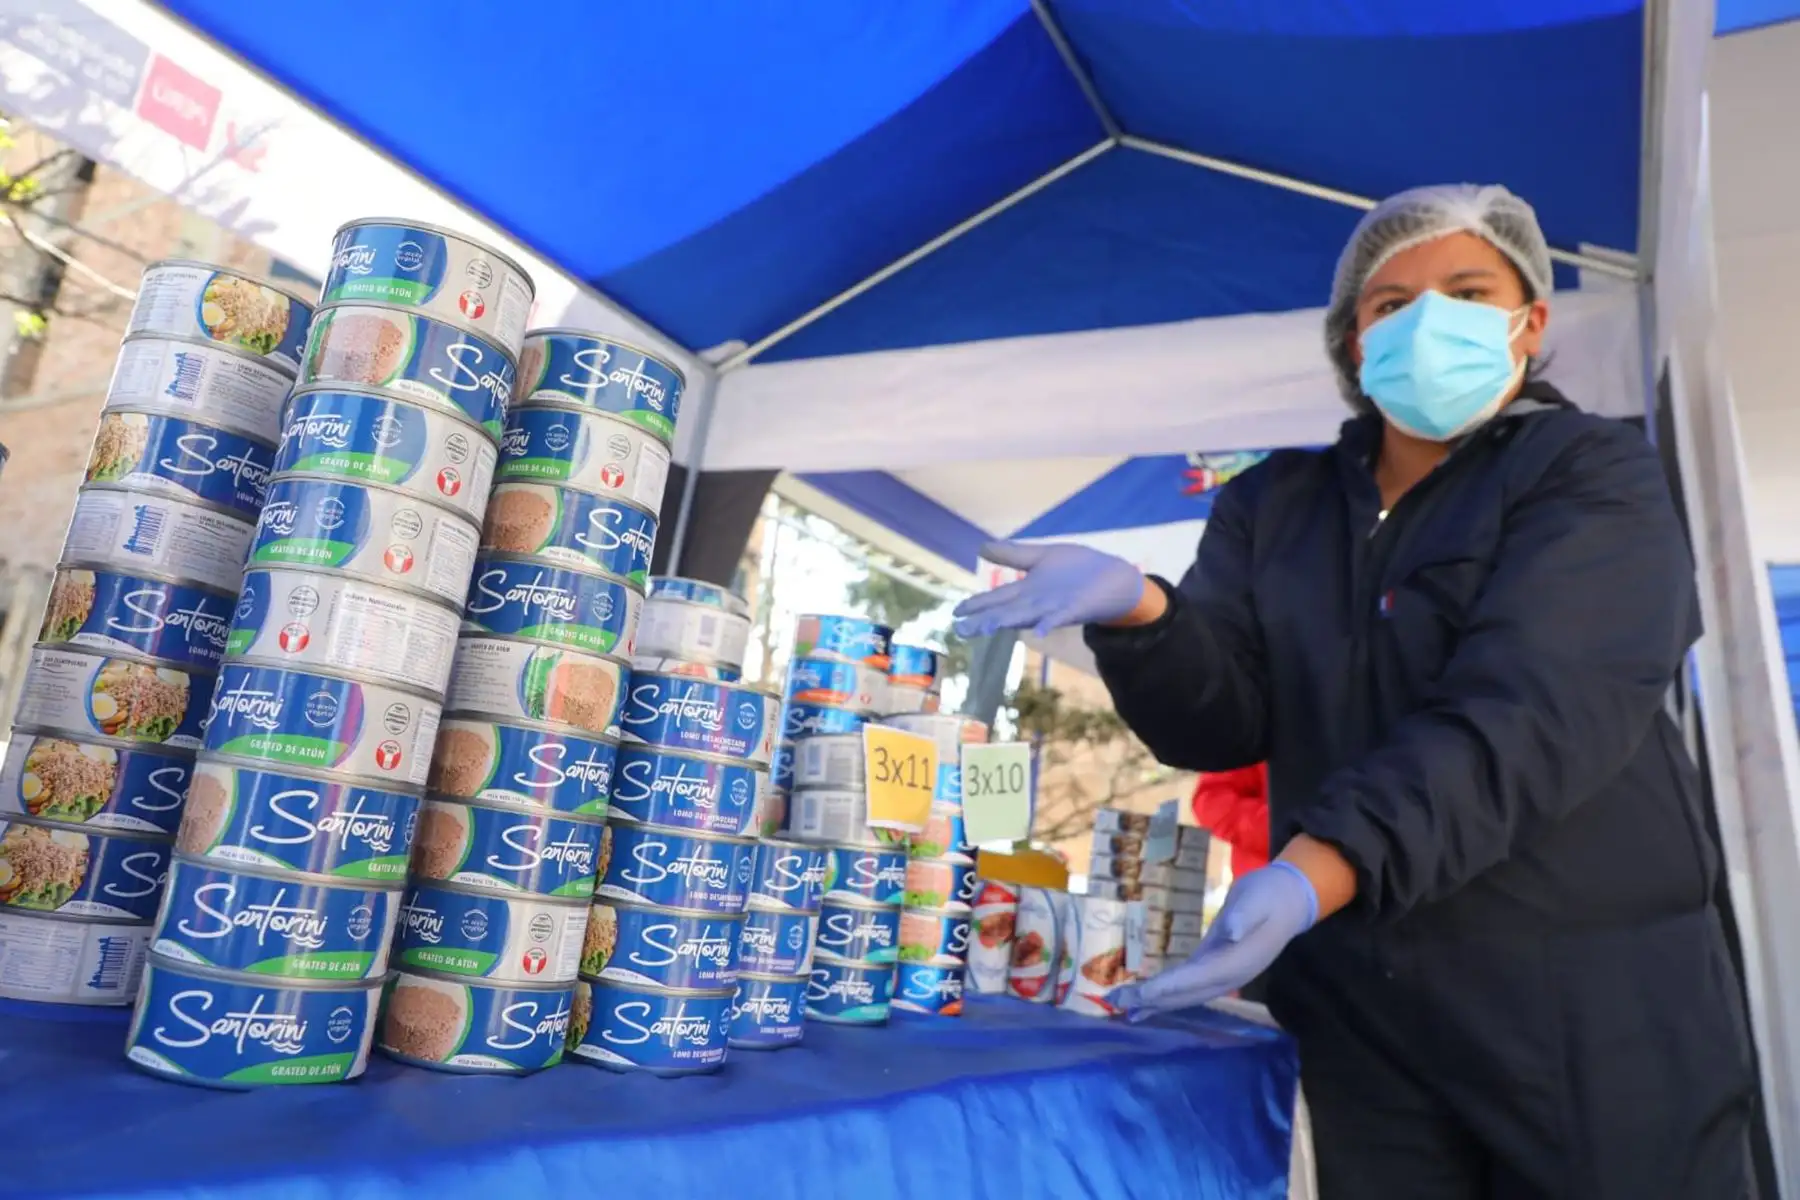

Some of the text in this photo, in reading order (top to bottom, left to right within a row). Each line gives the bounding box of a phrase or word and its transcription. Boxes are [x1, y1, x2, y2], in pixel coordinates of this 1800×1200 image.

[559, 349, 666, 400] Santorini
[575, 508, 653, 560] Santor
[468, 570, 577, 616] Santorini
[199, 672, 284, 728] Santorini
[623, 684, 725, 728] Santorini
[613, 761, 717, 806] Santorini
[873, 746, 933, 792] 3x11
[966, 761, 1025, 797] 3x10
[250, 789, 395, 851] Santorini
[487, 824, 594, 875] Santorini
[621, 842, 729, 888] Santorini
[178, 882, 329, 947] Santorini
[629, 924, 732, 968] Santorini
[154, 990, 308, 1056] Santorini
[602, 1002, 711, 1048] Santorini
[271, 1065, 308, 1077] GRATED
